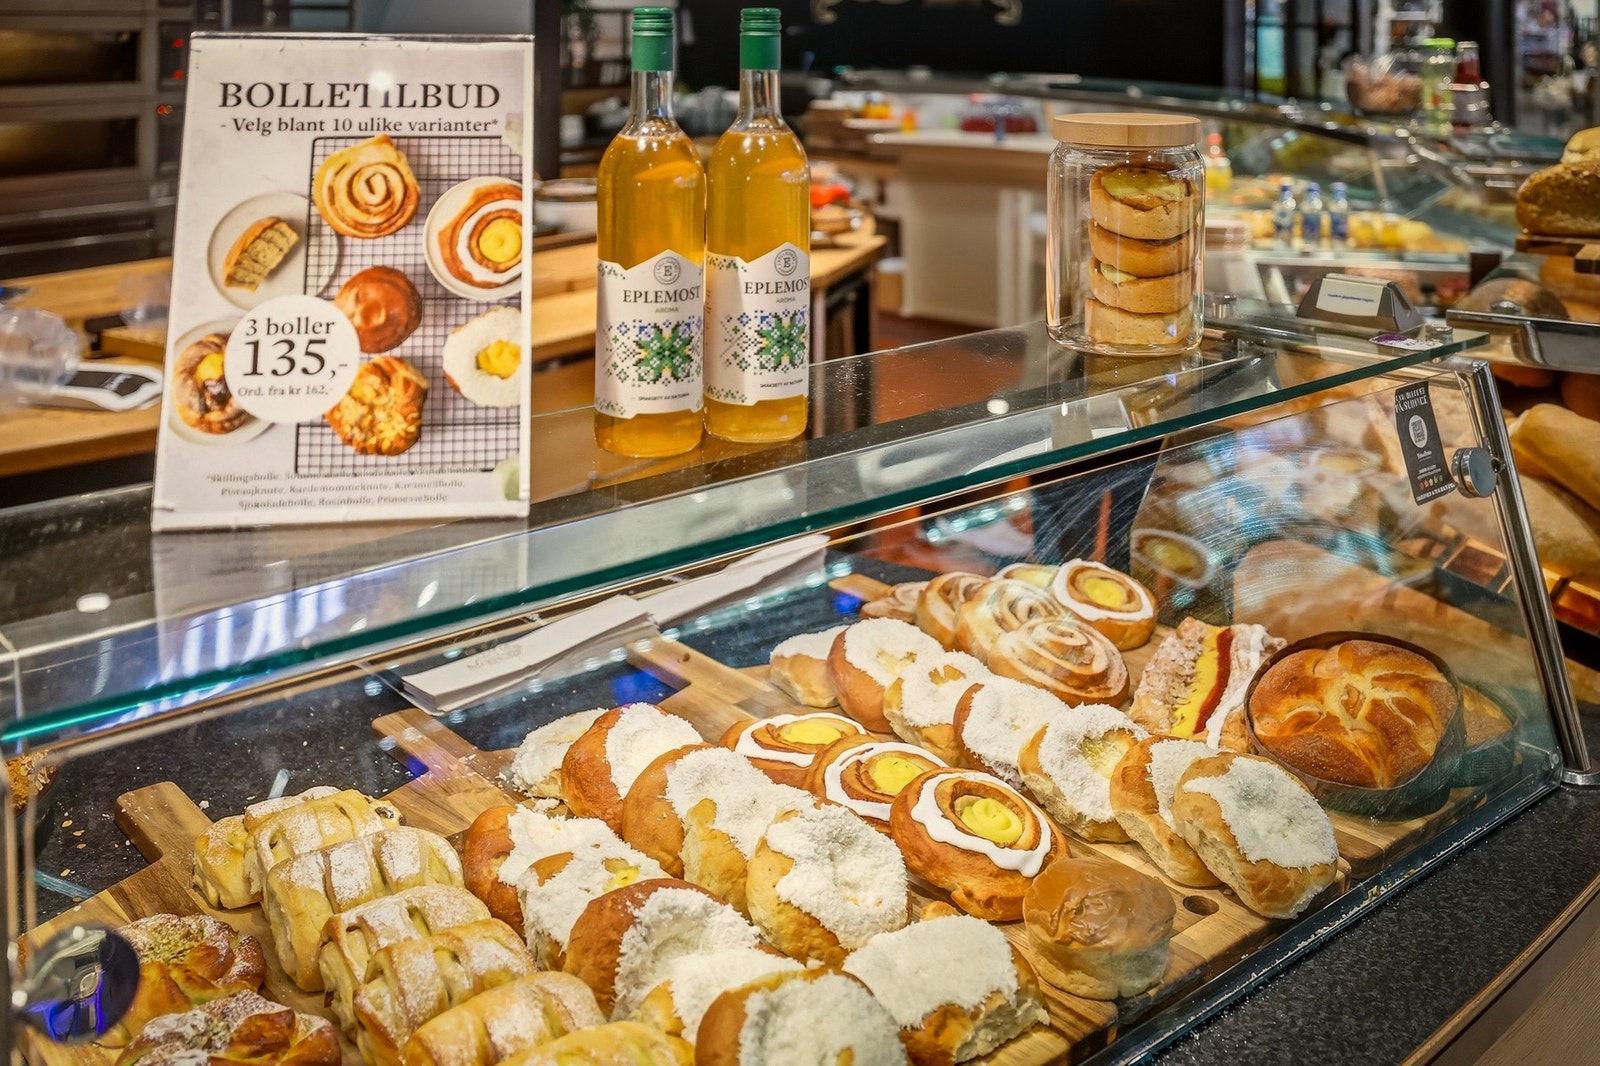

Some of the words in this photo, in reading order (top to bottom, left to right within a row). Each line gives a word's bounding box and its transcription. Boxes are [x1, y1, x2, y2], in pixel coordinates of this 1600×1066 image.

[218, 82, 500, 109] BOLLETILBUD
[232, 117, 272, 136] Velg
[278, 117, 325, 132] blant
[333, 118, 352, 132] 10
[358, 117, 402, 132] ulike
[623, 285, 700, 304] EPLEMOST
[245, 318, 257, 336] 3
[266, 316, 335, 336] boller
[243, 338, 348, 380] 135,-
[237, 386, 265, 397] Ord.
[268, 385, 285, 396] fra
[288, 385, 302, 396] kr
